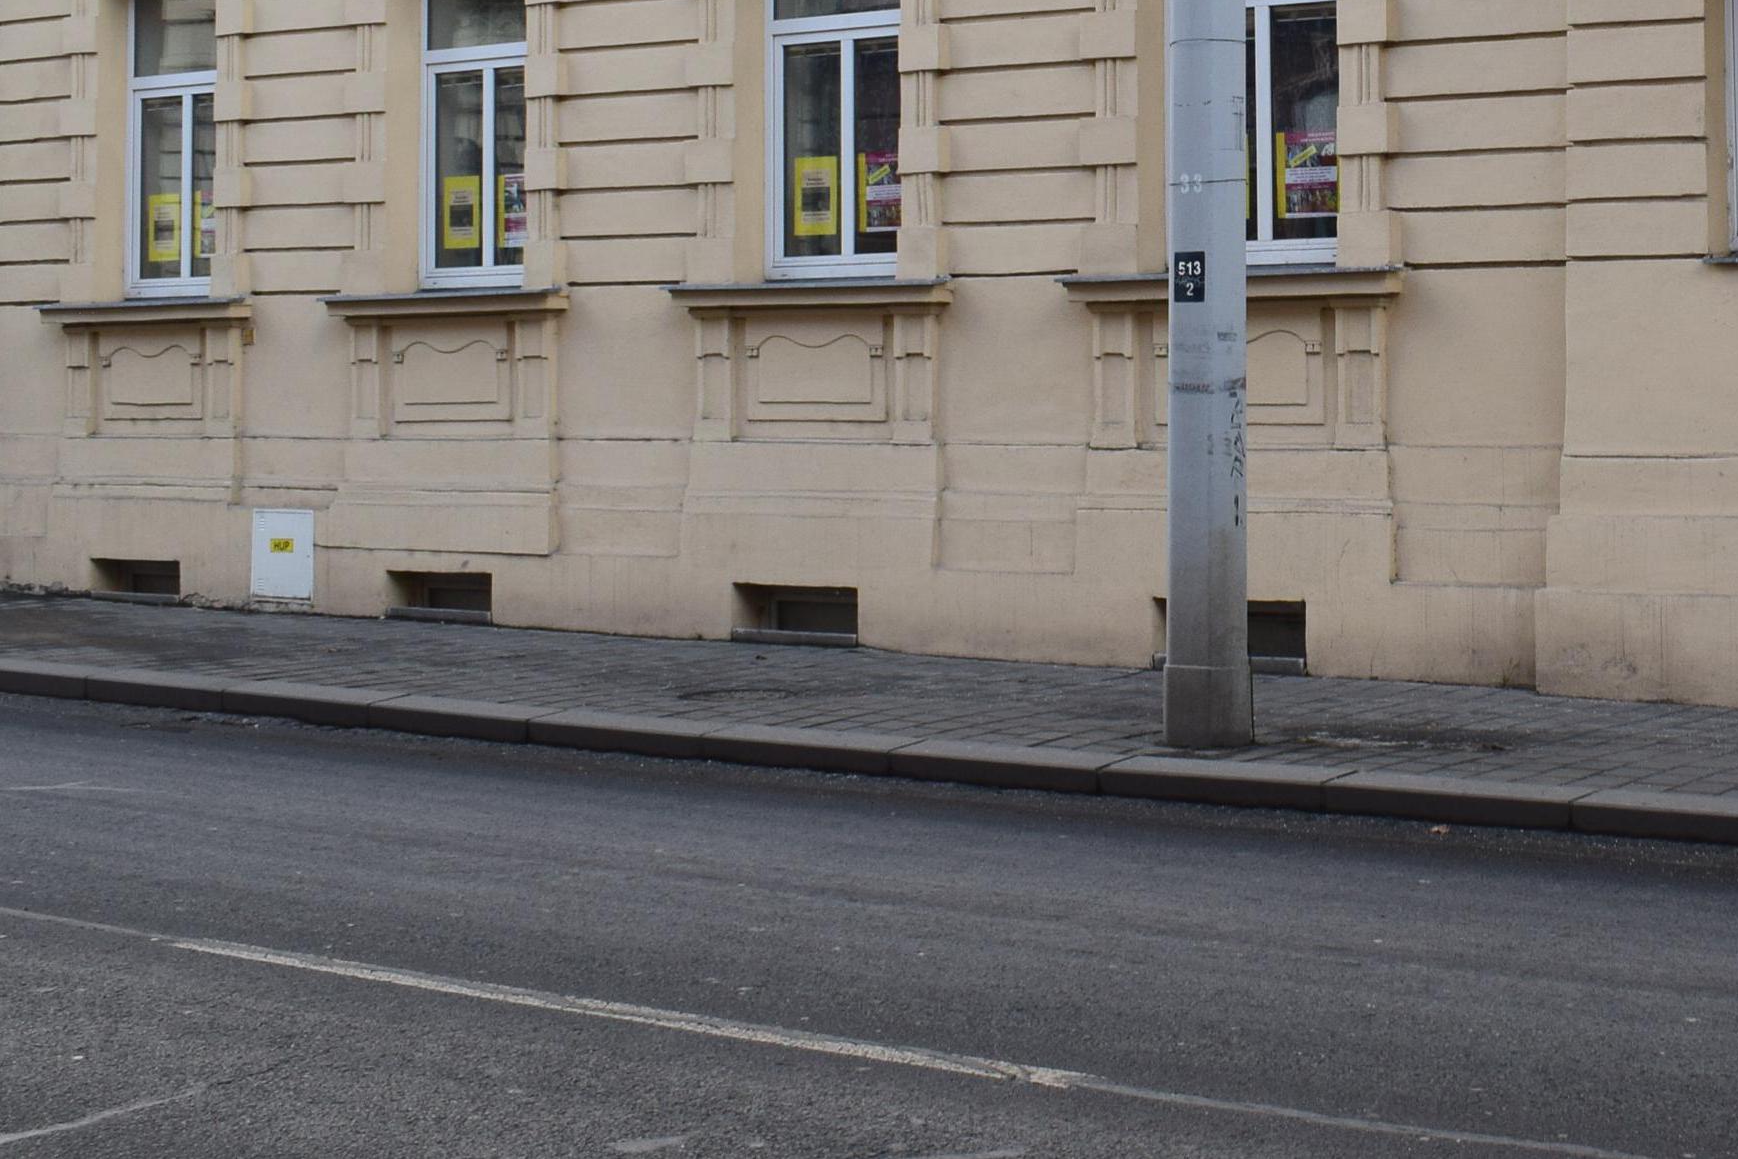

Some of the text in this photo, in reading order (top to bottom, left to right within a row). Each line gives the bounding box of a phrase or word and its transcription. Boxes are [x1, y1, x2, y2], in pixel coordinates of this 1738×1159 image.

[1178, 261, 1202, 276] 513
[1186, 283, 1194, 296] 2
[274, 541, 290, 551] HUP
